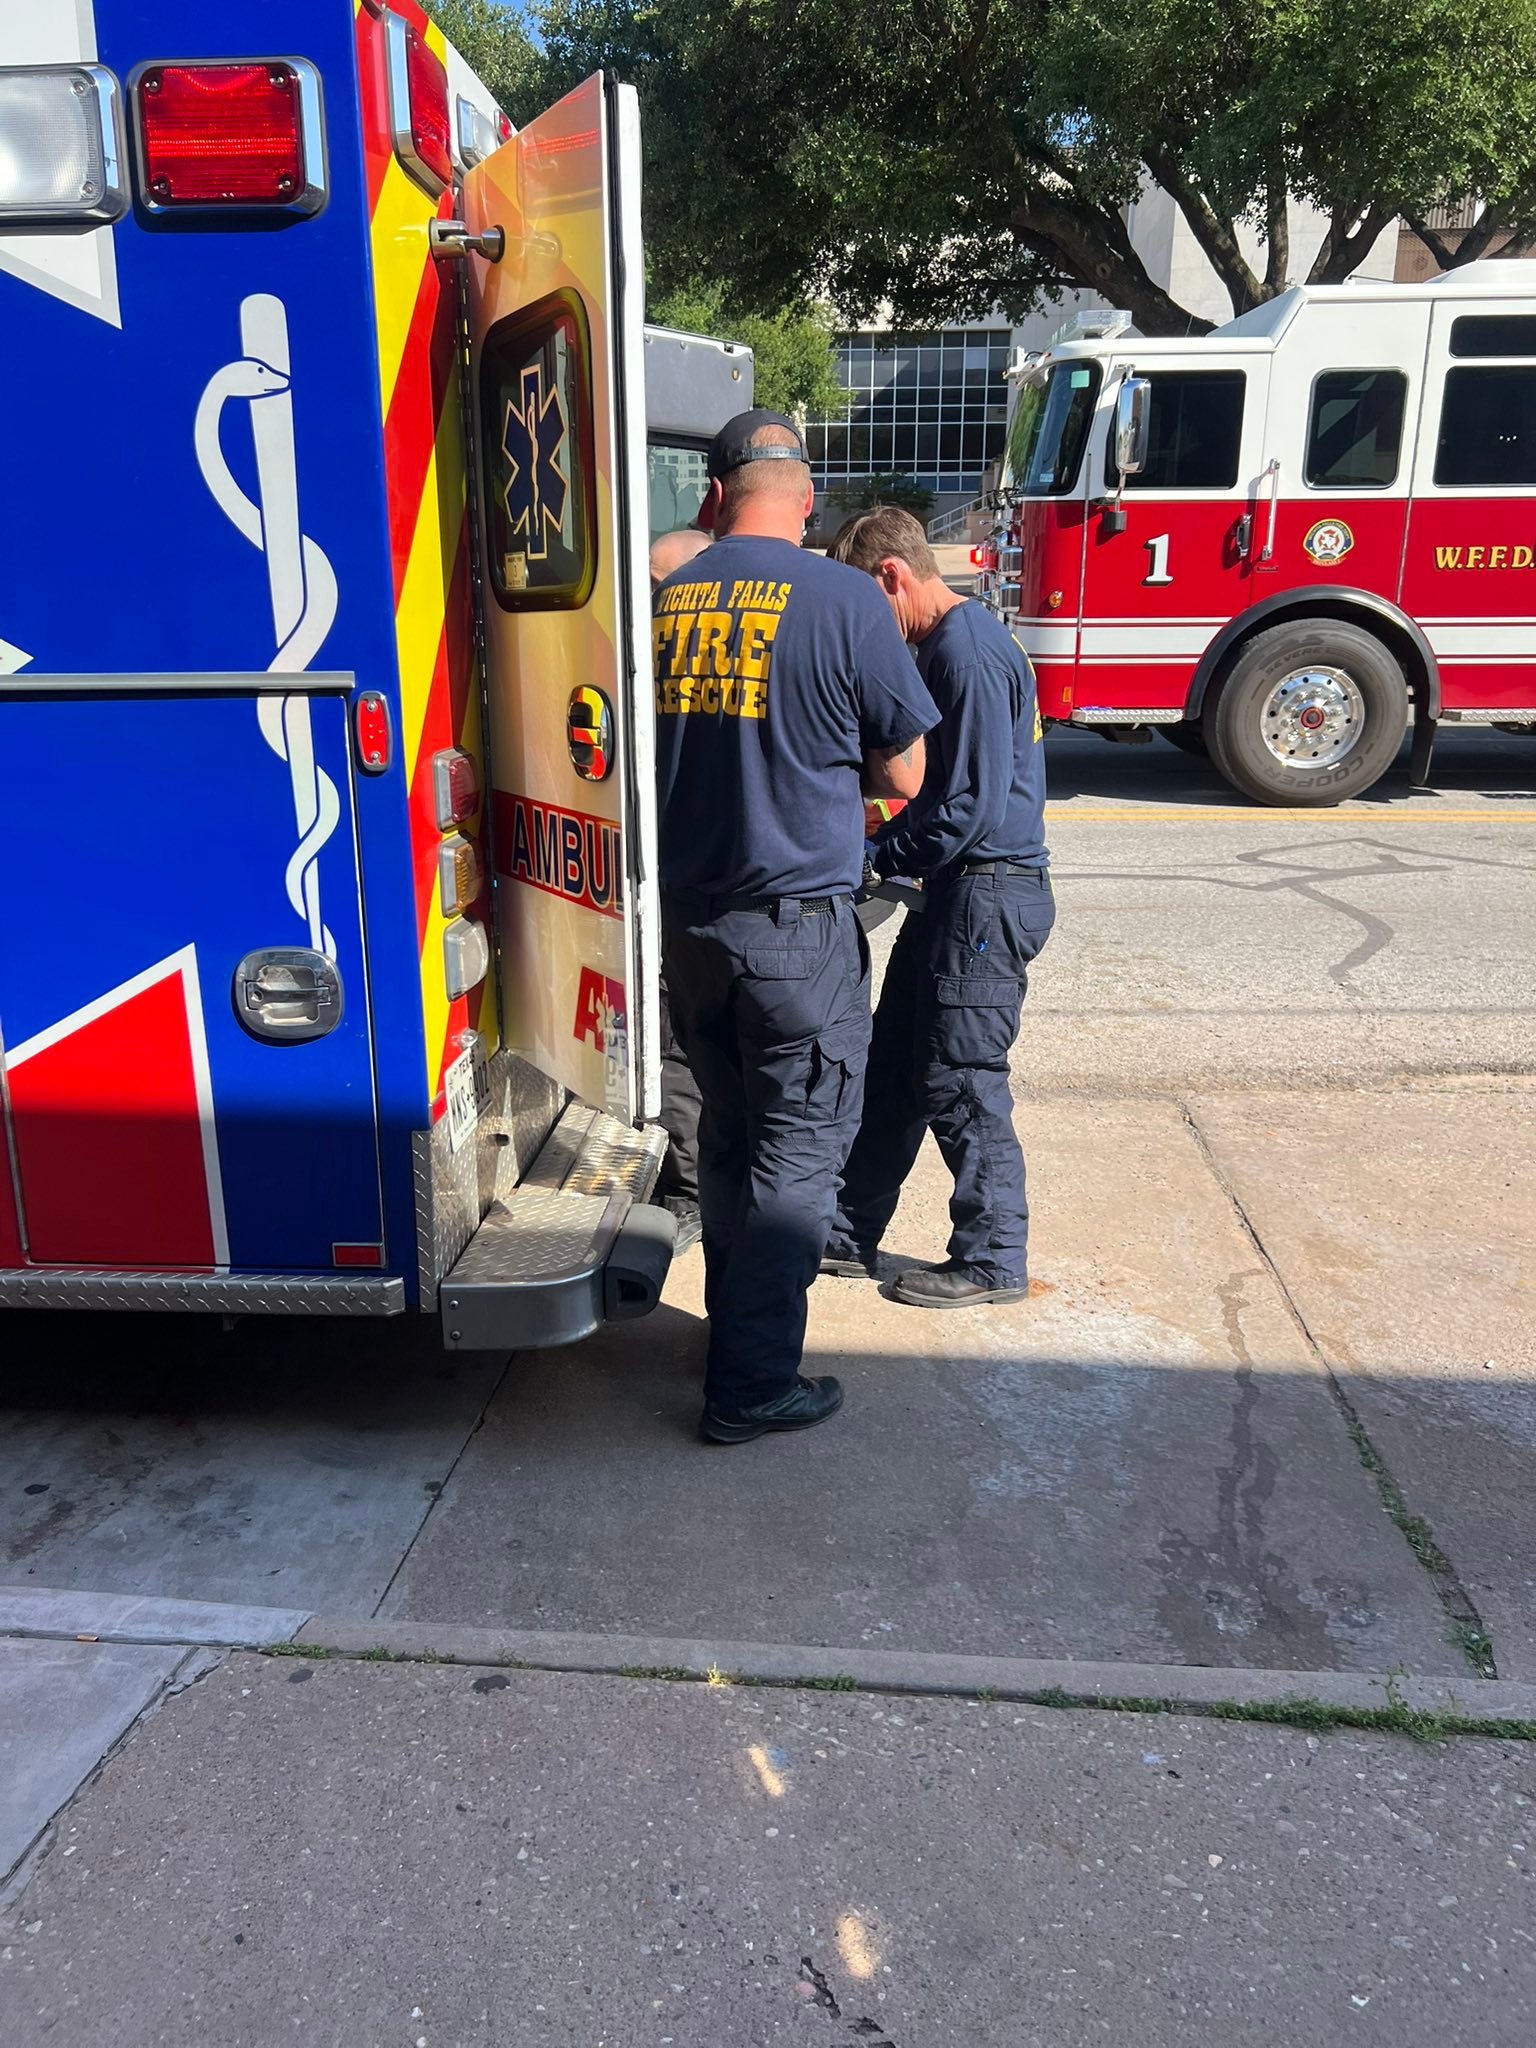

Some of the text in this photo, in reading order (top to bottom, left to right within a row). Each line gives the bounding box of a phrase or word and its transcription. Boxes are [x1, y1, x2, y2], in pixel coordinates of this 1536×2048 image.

[1142, 533, 1173, 586] 1
[1435, 546, 1535, 569] W.F.F.D.
[727, 580, 793, 612] FALLS
[652, 611, 781, 679] FIRE
[1263, 756, 1364, 788] COOPER
